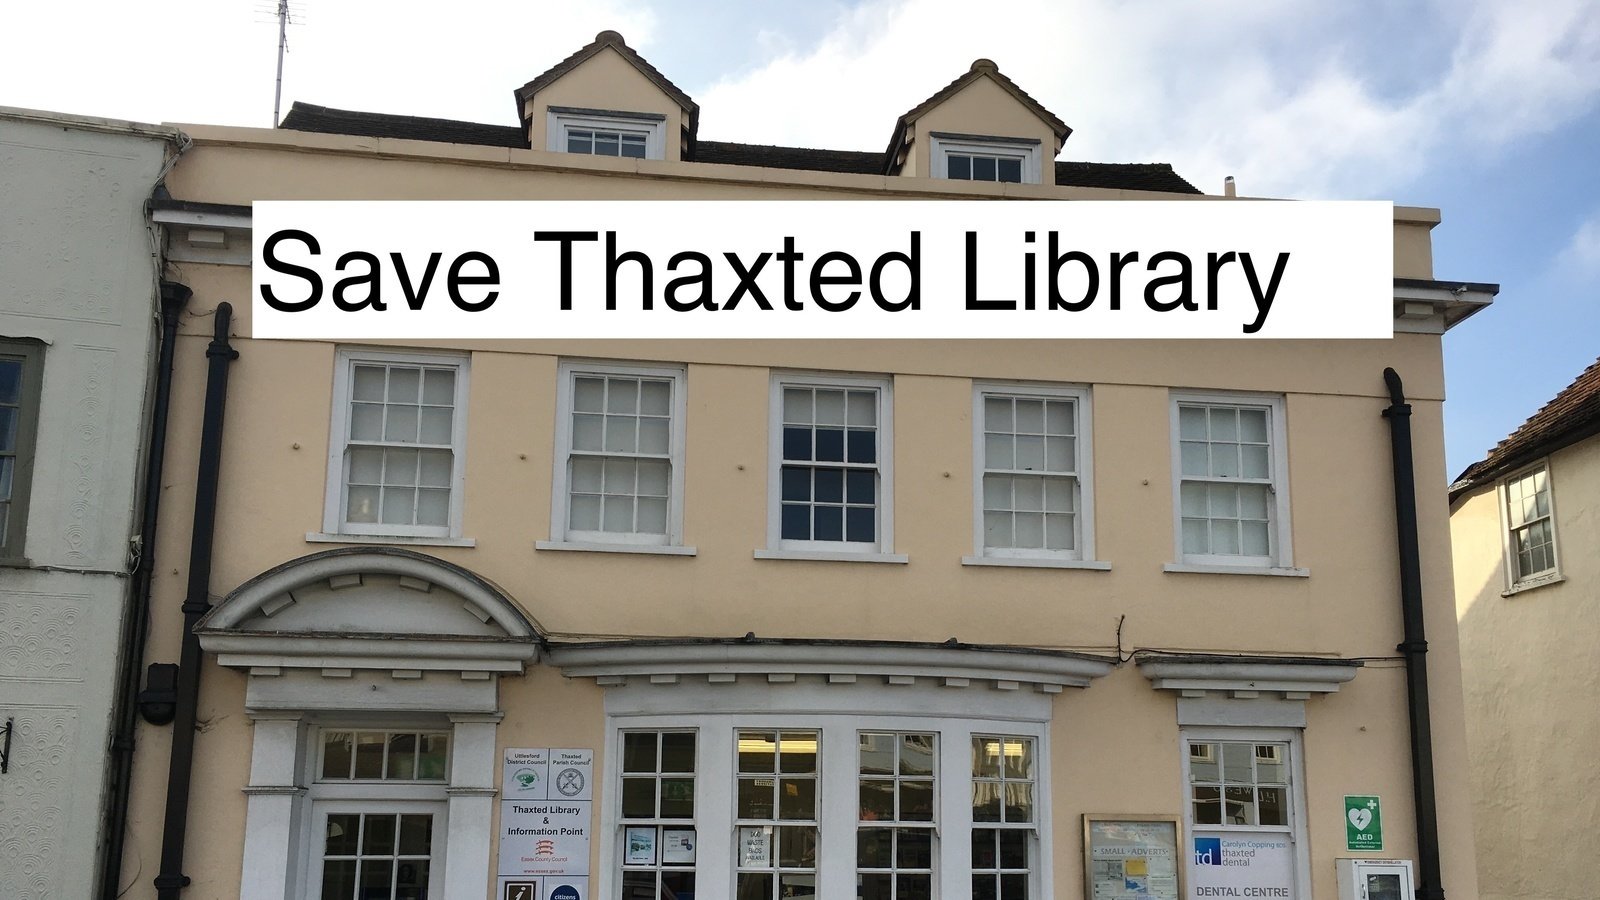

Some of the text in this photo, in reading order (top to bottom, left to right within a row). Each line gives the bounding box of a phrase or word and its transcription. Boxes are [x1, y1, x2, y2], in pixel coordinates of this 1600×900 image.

[512, 805, 581, 816] Thaxted Library
[542, 816, 550, 825] &
[507, 827, 584, 836] Information Point
[1356, 833, 1374, 841] AED
[1221, 840, 1247, 849] Carolyn
[1247, 841, 1275, 850] Copping
[1099, 847, 1167, 856] SMALL ADVERTS
[1221, 848, 1256, 857] thaxted
[1195, 848, 1213, 866] td
[1222, 858, 1250, 867] dental
[1196, 886, 1289, 898] DENTAL CENTRE
